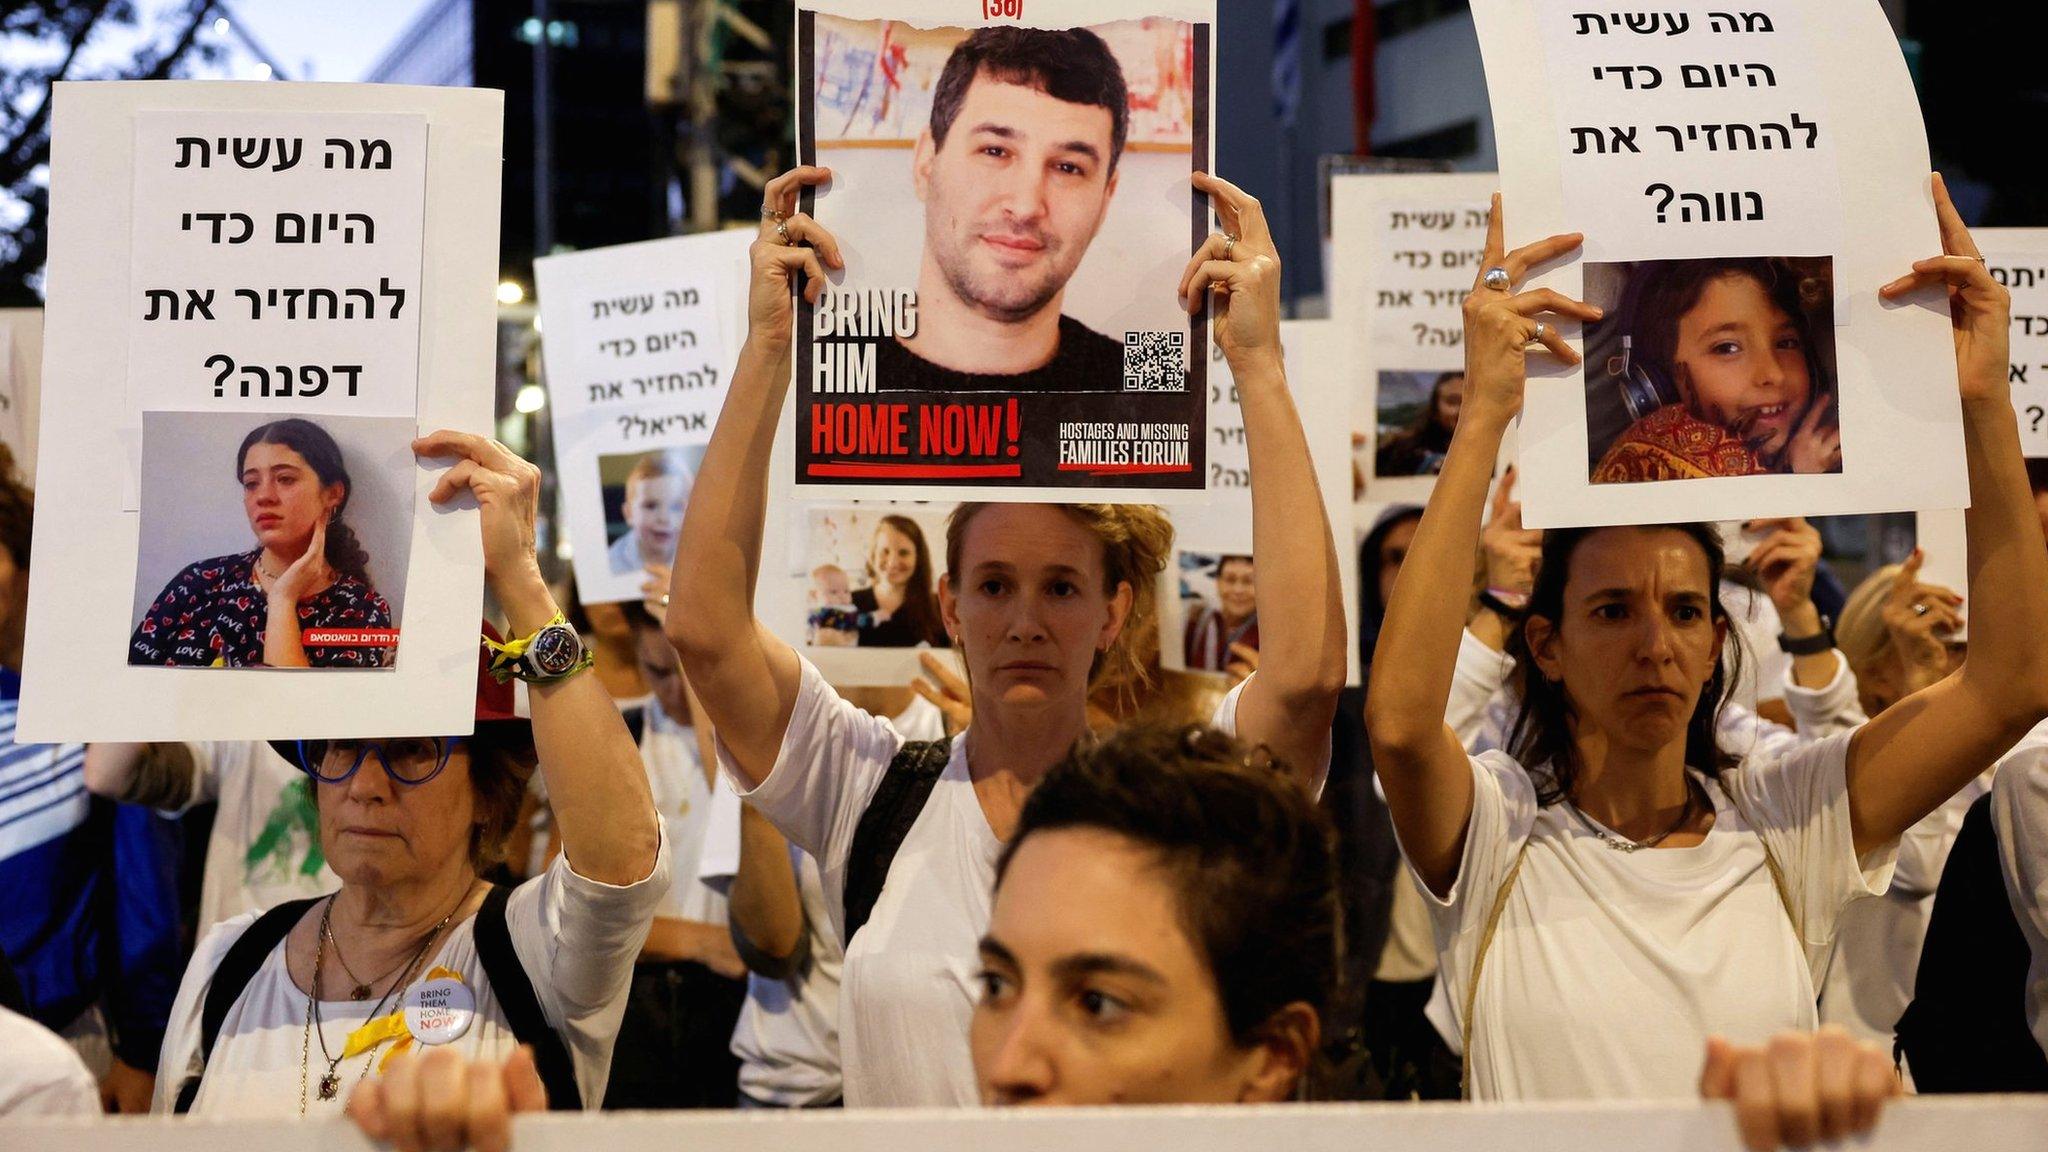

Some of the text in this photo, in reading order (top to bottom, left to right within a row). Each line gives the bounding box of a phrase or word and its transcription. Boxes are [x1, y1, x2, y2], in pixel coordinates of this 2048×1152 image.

[1573, 12, 1775, 37] מה עשית
[1593, 63, 1776, 90] היום כדי
[1571, 112, 1819, 155] להחזיר את
[174, 137, 392, 172] מה עשית
[1644, 182, 1764, 224] נווה?
[181, 212, 375, 244] היום כדי
[1390, 211, 1456, 230] עשית
[1394, 251, 1432, 268] כדי
[143, 277, 406, 321] להחזיר את
[592, 287, 700, 319] מה עשית
[1377, 289, 1413, 306] את
[813, 287, 918, 340] BRING
[599, 329, 697, 357] היום כדי
[204, 354, 363, 398] דפנה?
[812, 342, 877, 394] HIM
[588, 363, 718, 403] להחזיר את
[617, 411, 707, 440] אריאל?
[811, 398, 1020, 457] HOME NOW!
[1060, 422, 1189, 441] HOSTAGES AND MISSING
[1060, 440, 1189, 466] FAMILIES FORUM
[421, 988, 451, 999] BRING
[421, 999, 447, 1008] THEM
[421, 1007, 449, 1018] HOME
